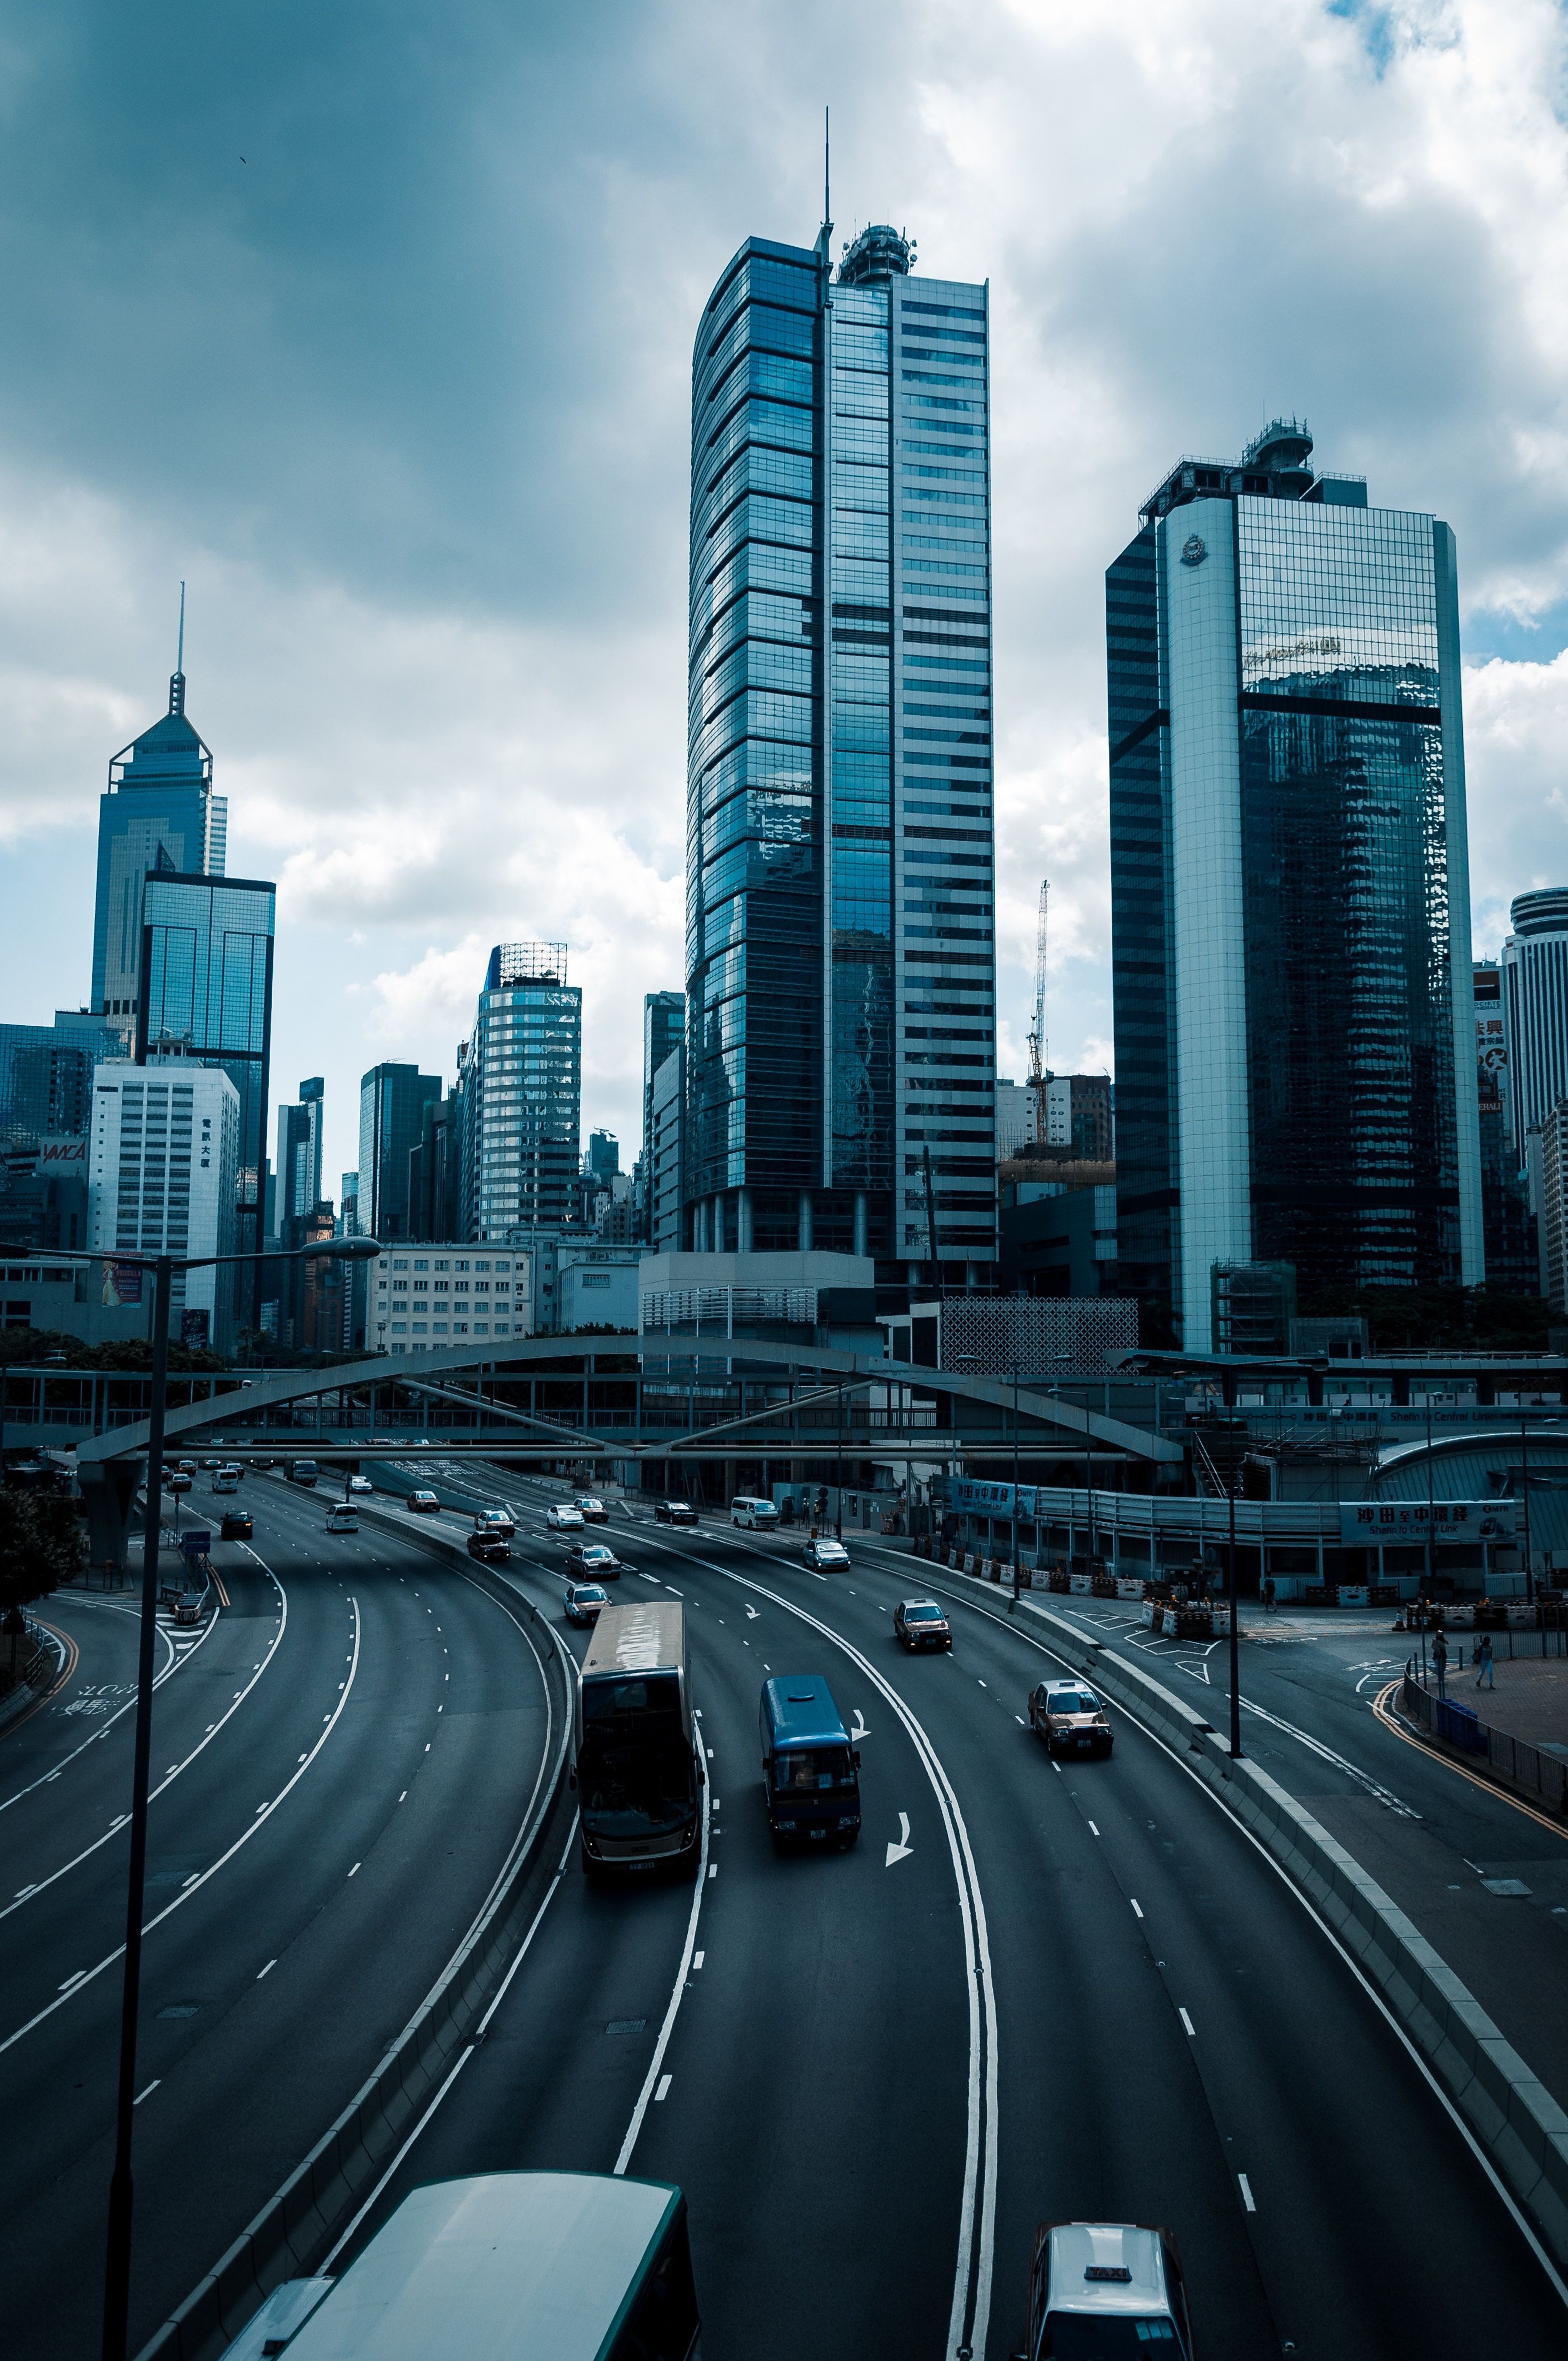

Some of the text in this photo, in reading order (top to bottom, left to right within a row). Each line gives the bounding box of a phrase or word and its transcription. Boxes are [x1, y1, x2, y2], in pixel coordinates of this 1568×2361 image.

[43, 1141, 86, 1165] YMCA
[1391, 1412, 1420, 1421] Shatin
[1434, 1412, 1468, 1421] Central
[1472, 1411, 1493, 1421] Link
[1369, 1524, 1459, 1534] Shatin to Centl Link
[1090, 2267, 1126, 2277] TAXI
